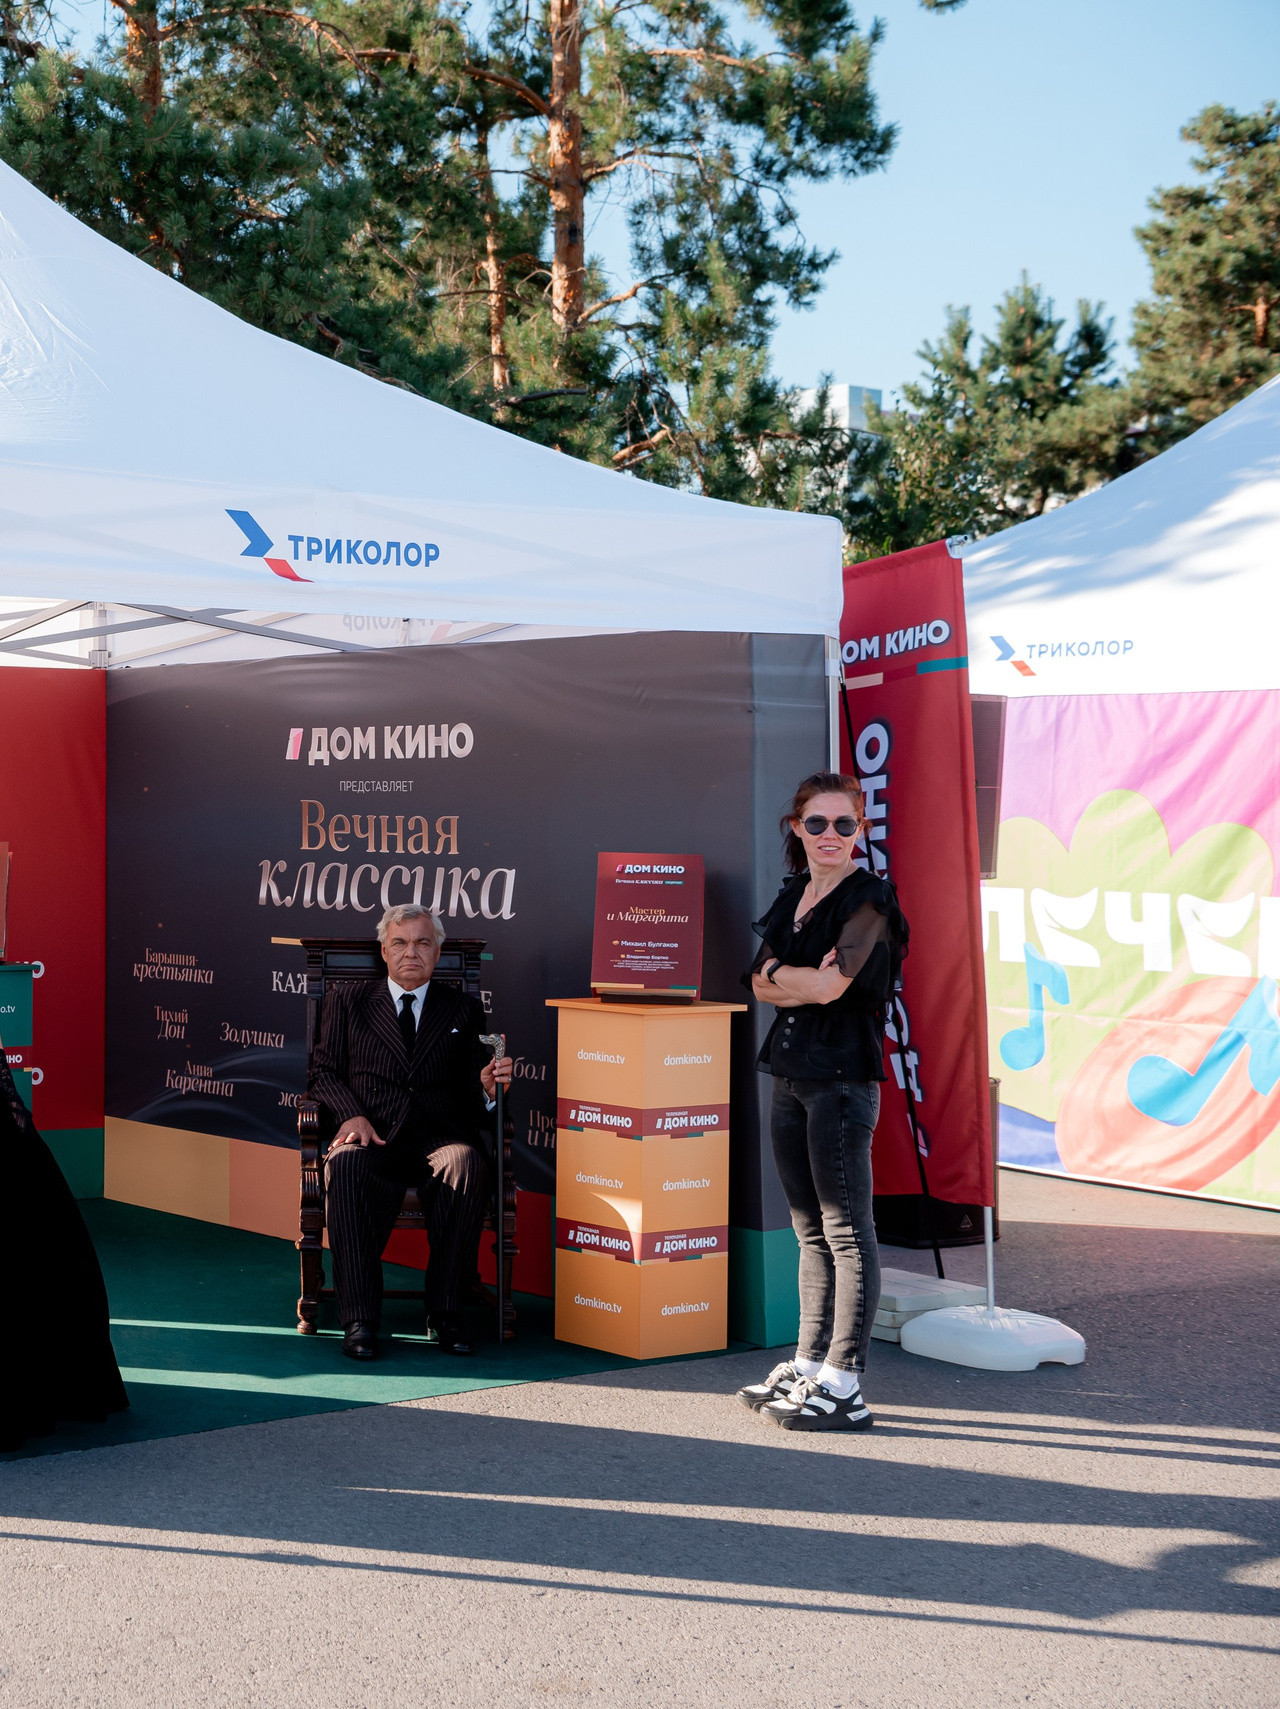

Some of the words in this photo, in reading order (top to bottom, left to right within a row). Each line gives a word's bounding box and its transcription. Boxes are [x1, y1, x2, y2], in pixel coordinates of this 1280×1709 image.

[287, 534, 440, 568] ТРИКОЛОР
[841, 635, 880, 664] ОМ
[885, 619, 950, 656] КИНО
[1026, 639, 1134, 659] ТРИКОЛОР
[308, 726, 376, 766] ДОМ
[384, 722, 474, 759] КИНО
[339, 780, 414, 793] ПРЕДСТАВЛЯЕТ
[299, 799, 460, 855] Вечная
[624, 864, 651, 873] ДОМ
[653, 865, 685, 874] КИНО
[258, 859, 516, 920] классика
[606, 913, 615, 921] и
[617, 911, 689, 925] Маргарита
[629, 906, 666, 917] Мастер
[145, 947, 199, 967] Барышня-
[133, 962, 215, 985] крестьянка
[154, 1005, 189, 1024] Тихий
[157, 1019, 186, 1041] Дон
[219, 1021, 285, 1049] Золушка
[577, 1048, 625, 1065] domkino.tv
[663, 1053, 712, 1066] domkino.tv
[184, 1060, 213, 1078] Анна
[165, 1068, 234, 1098] Каренина
[577, 1109, 601, 1123] ДОМ
[602, 1113, 633, 1128] КИНО
[663, 1117, 688, 1130] ДОМ
[689, 1114, 720, 1127] КИНО
[575, 1171, 624, 1189] domkino.tv
[662, 1177, 711, 1191] domkino.tv
[575, 1231, 599, 1245] ДОМ
[601, 1236, 631, 1252] КИНО
[662, 1238, 687, 1254] ДОМ
[688, 1235, 718, 1249] КИНО
[574, 1293, 623, 1314] domkino.tv
[661, 1301, 710, 1316] domkino.tv
